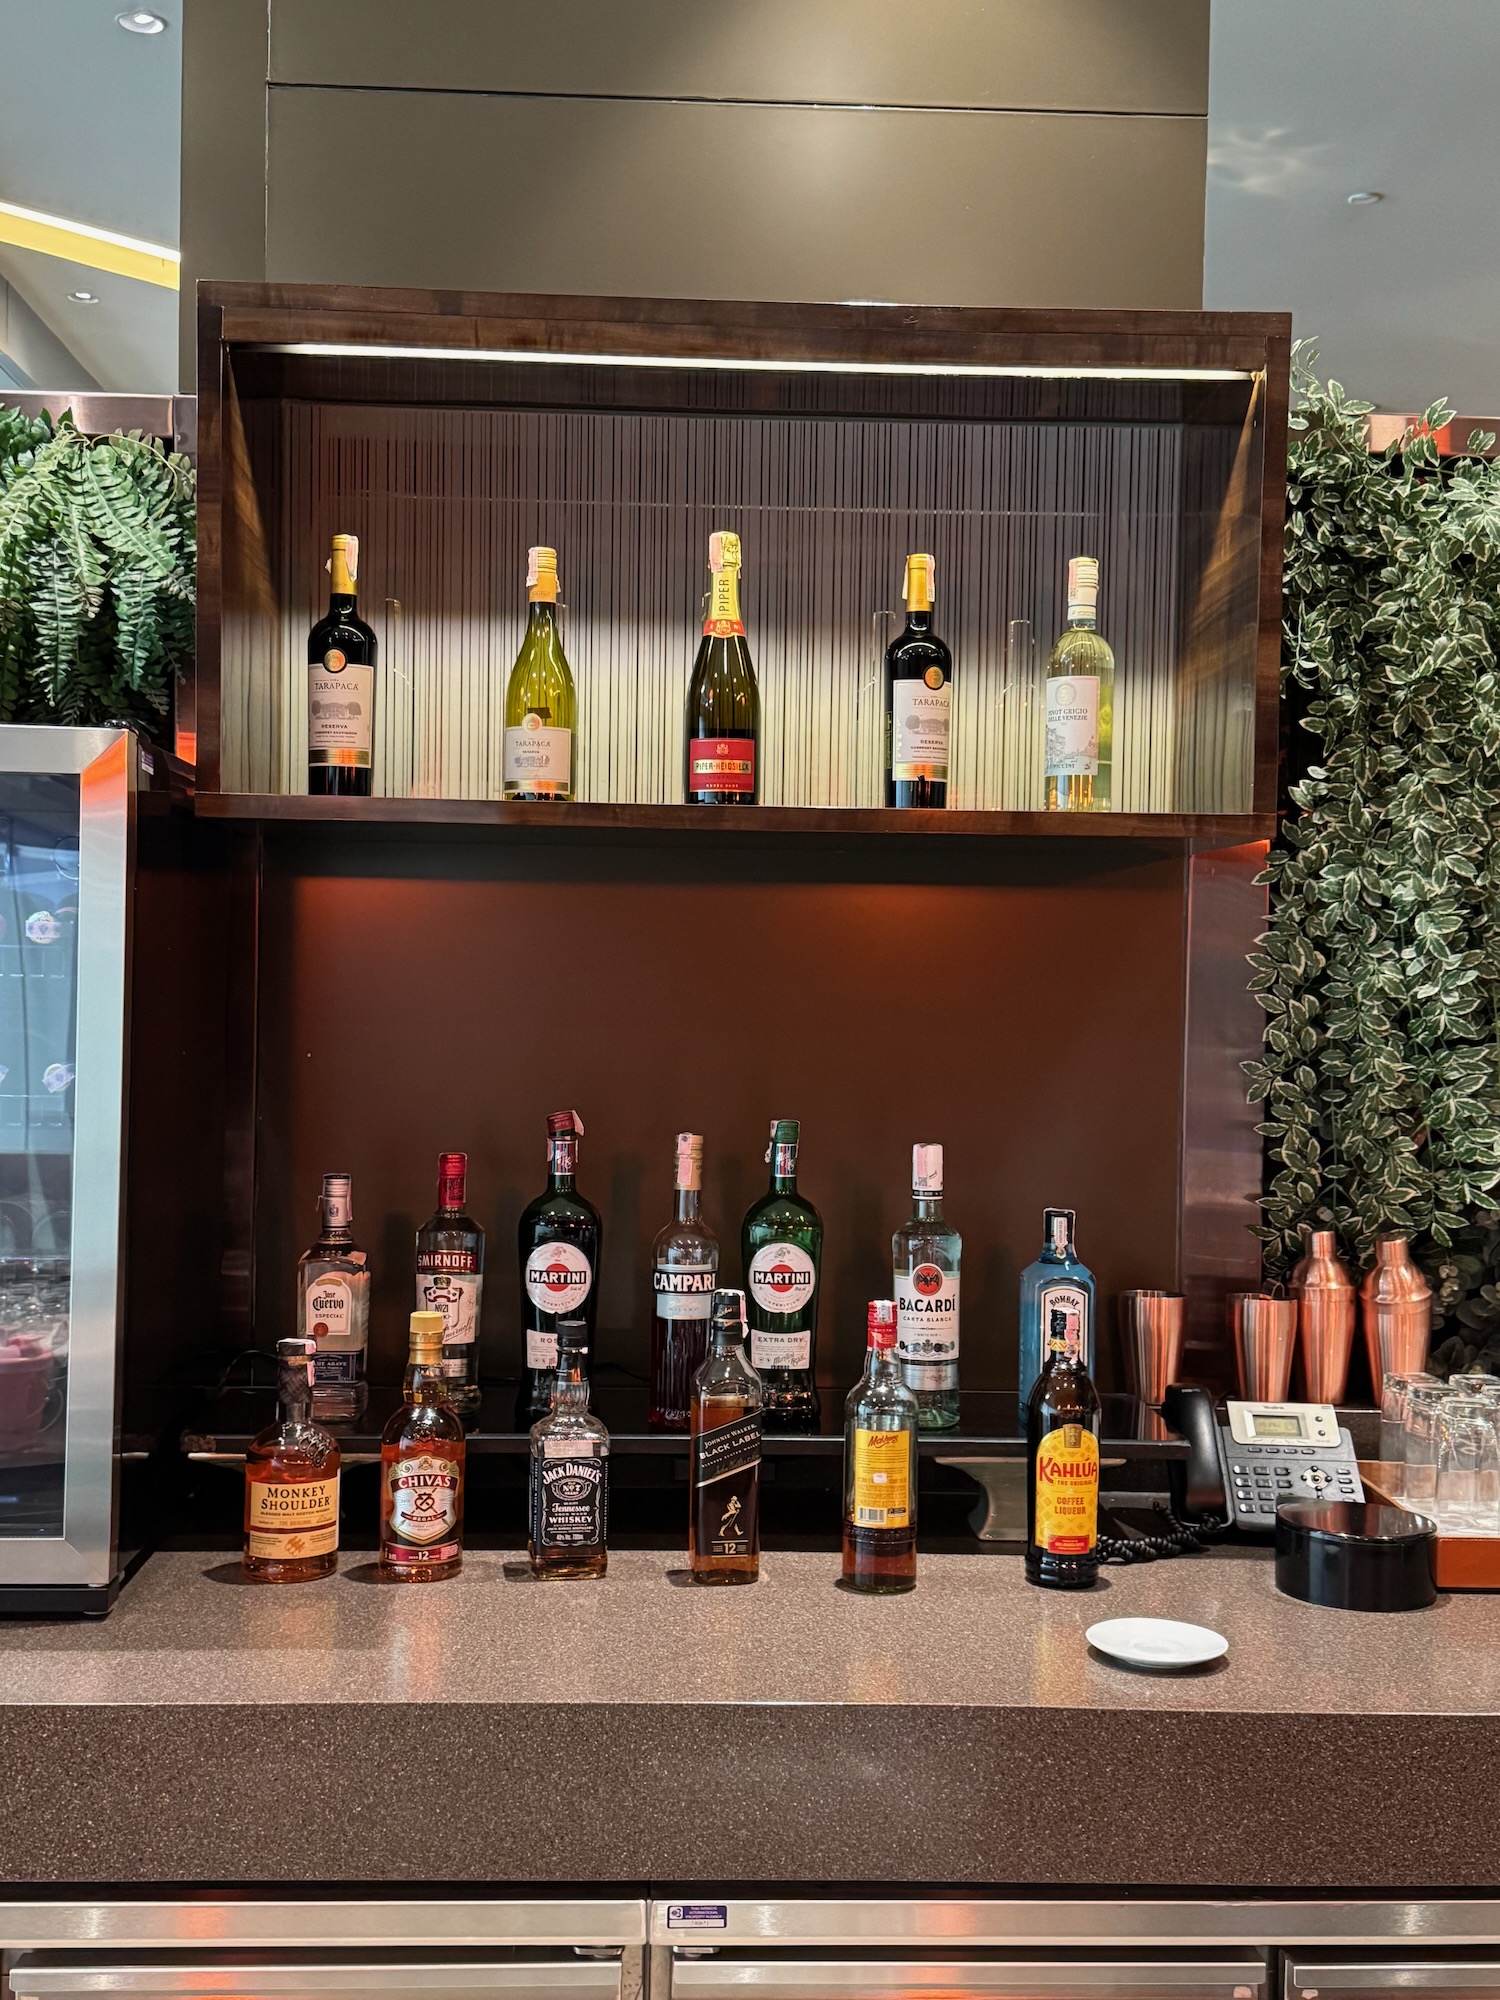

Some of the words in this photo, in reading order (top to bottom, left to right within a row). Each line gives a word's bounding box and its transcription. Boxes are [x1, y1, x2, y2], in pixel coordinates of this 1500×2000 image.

[718, 579, 730, 612] PIPER
[417, 1254, 473, 1268] SMIRNOFF
[530, 1272, 585, 1283] MARTINI
[654, 1273, 716, 1292] CAMPARI
[755, 1272, 809, 1284] MARTINI
[313, 1296, 344, 1311] Cuervo
[1049, 1295, 1080, 1306] BOMBAY
[699, 1443, 730, 1460] BLACK
[732, 1431, 761, 1447] LABEL
[704, 1434, 730, 1449] JOHNNIE
[542, 1465, 566, 1484] JACK
[566, 1462, 602, 1484] DANIEL'S
[1039, 1456, 1097, 1484] KAHLÚA
[398, 1475, 451, 1488] CHIVAS
[267, 1485, 326, 1499] MONKEY
[261, 1496, 330, 1511] SHOULDER
[552, 1503, 590, 1512] Tennessee
[1056, 1496, 1085, 1505] COFFEE
[1054, 1506, 1086, 1515] LIQUEUR
[418, 1551, 429, 1560] 12
[724, 1543, 736, 1554] 12
